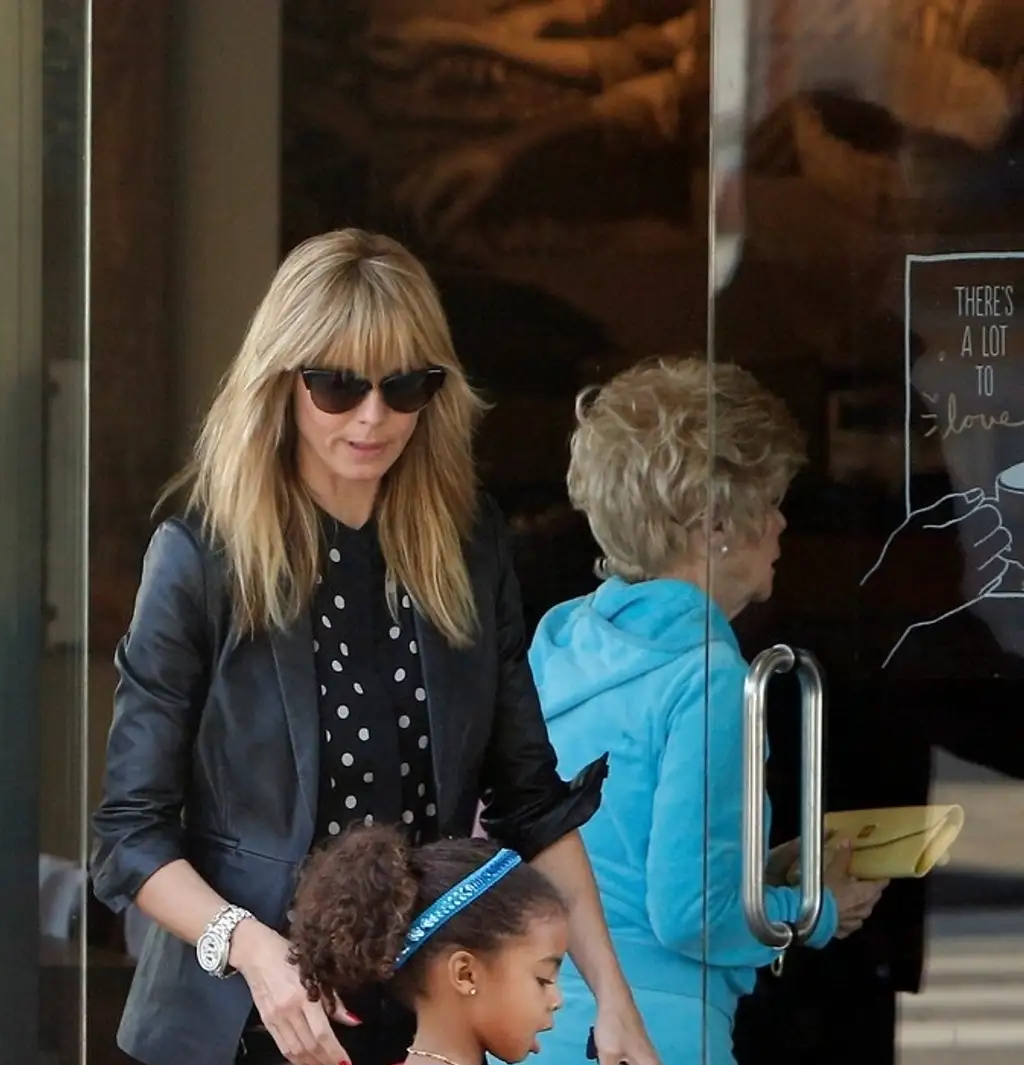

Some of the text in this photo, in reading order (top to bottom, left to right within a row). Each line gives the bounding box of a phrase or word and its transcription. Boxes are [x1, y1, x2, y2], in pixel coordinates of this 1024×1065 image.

[954, 285, 1014, 317] THERE'S
[960, 325, 1008, 357] A LOT
[976, 365, 994, 396] TO
[943, 392, 1024, 439] love
